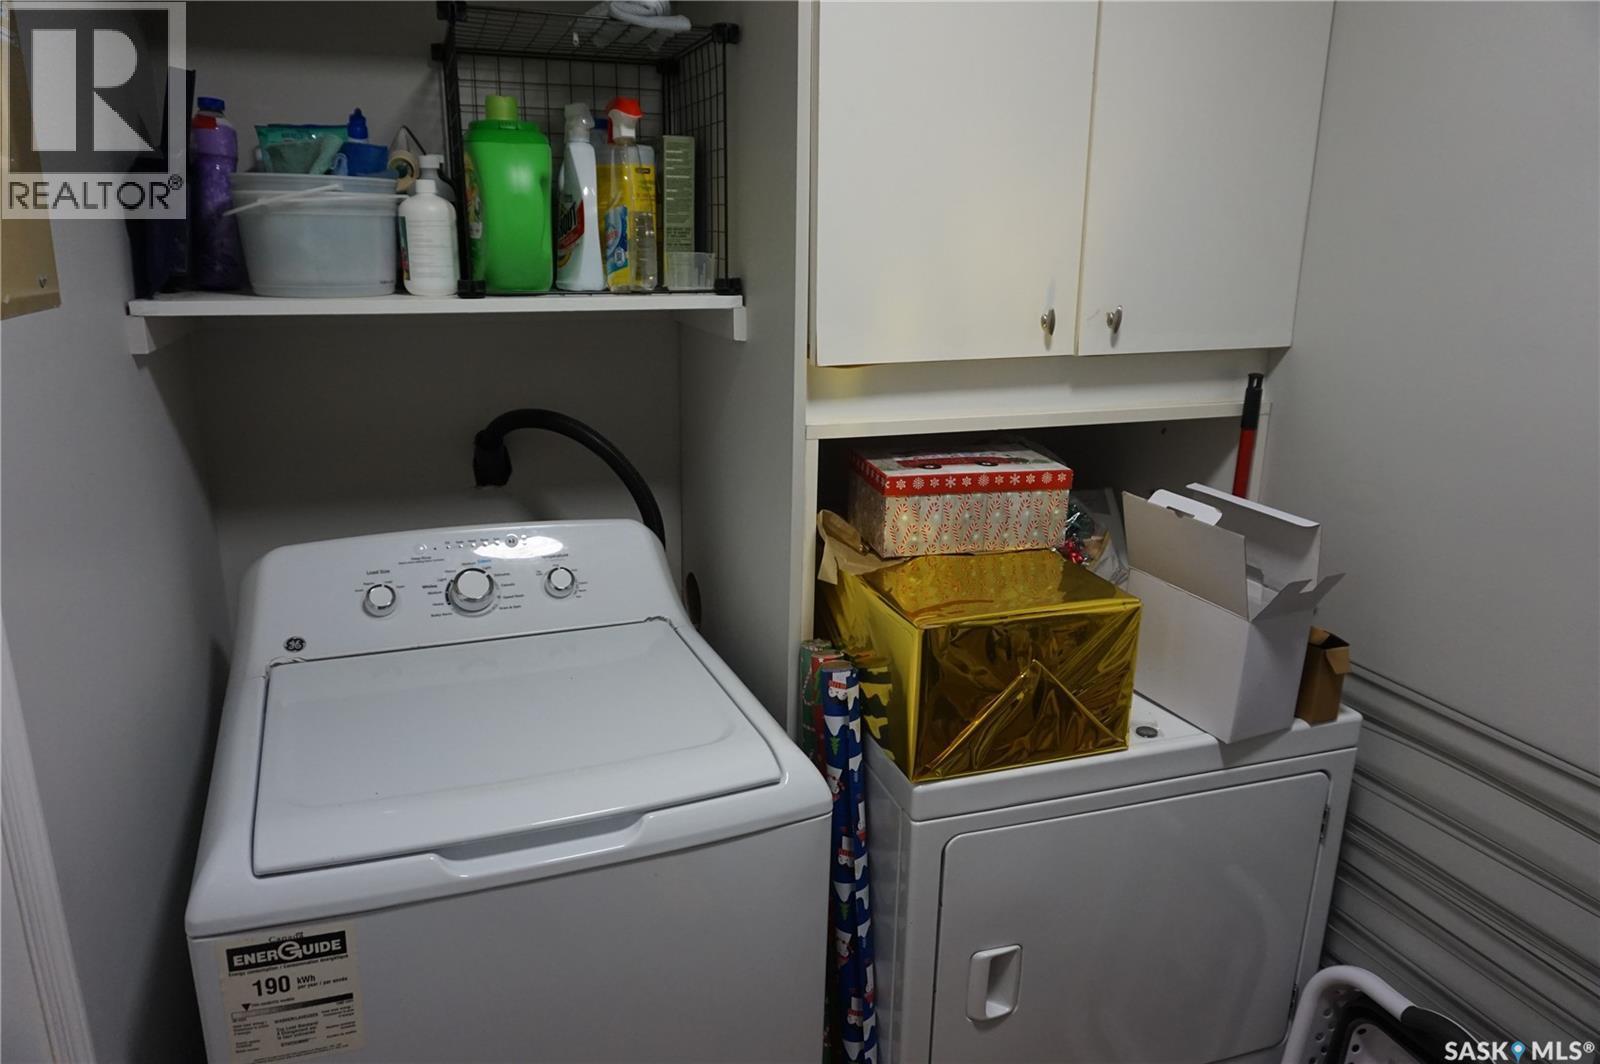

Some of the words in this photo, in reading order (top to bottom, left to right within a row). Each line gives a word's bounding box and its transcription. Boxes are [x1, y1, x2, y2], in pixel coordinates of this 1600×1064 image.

[232, 939, 342, 967] ENERGUIDE
[252, 974, 291, 997] 190
[296, 974, 316, 985] kWh
